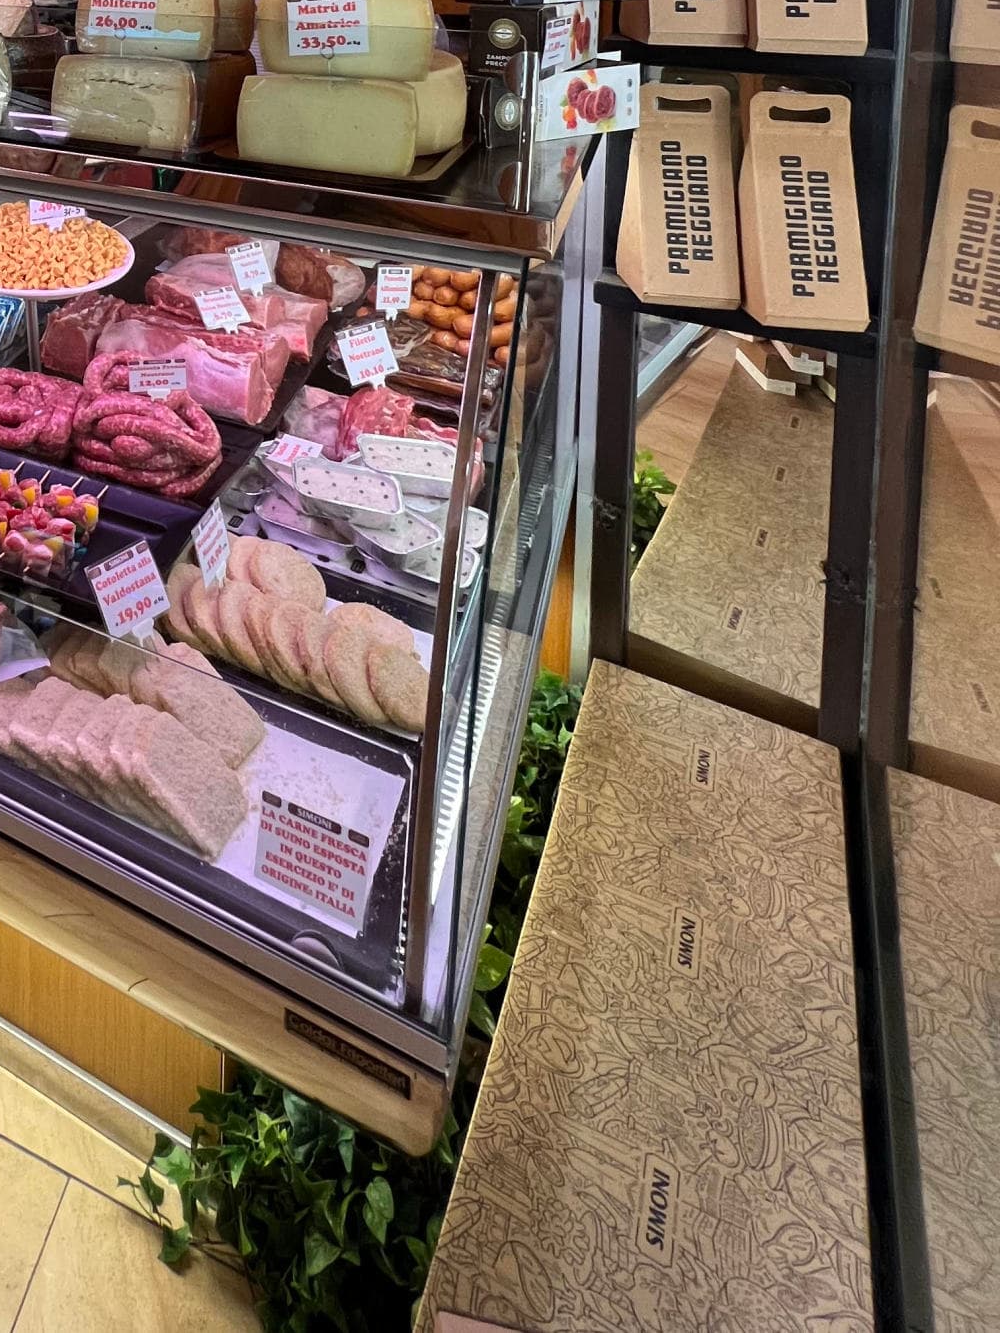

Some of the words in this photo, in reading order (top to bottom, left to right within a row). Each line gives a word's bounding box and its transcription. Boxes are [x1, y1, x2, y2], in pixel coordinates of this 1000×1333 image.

[96, 16, 138, 30] 26,00
[296, 18, 361, 31] Amatrice
[298, 2, 340, 15] Matrù
[342, 1, 356, 12] di
[301, 34, 347, 50] 33,50
[486, 53, 513, 61] ZAMPO
[660, 140, 690, 275] PARMIGIANO
[685, 155, 714, 262] REGGIANO
[779, 155, 815, 298] PARMIGIANO
[807, 170, 840, 283] REGGIANO
[348, 346, 385, 362] Nostrano
[349, 335, 376, 348] Filetto
[102, 572, 157, 606] Valdostana
[117, 596, 152, 625] 19,90
[696, 749, 710, 786] SIMONI
[261, 807, 276, 820] LA
[278, 814, 318, 838] CARNE
[321, 833, 367, 862] FRESCA
[296, 808, 333, 831] SIMONI
[261, 820, 273, 833] DI
[275, 825, 310, 849] SUINO
[313, 844, 366, 876] ESPOSTA
[279, 843, 292, 856] IN
[295, 851, 342, 880] QUESTO
[261, 864, 313, 896] ORIGINE:
[315, 890, 356, 918] ITALIA
[265, 851, 325, 888] ESERCIZIO
[327, 882, 339, 893] E'
[341, 888, 355, 901] DI
[677, 917, 697, 969] SIMONI
[646, 1168, 670, 1251] SIMONI
